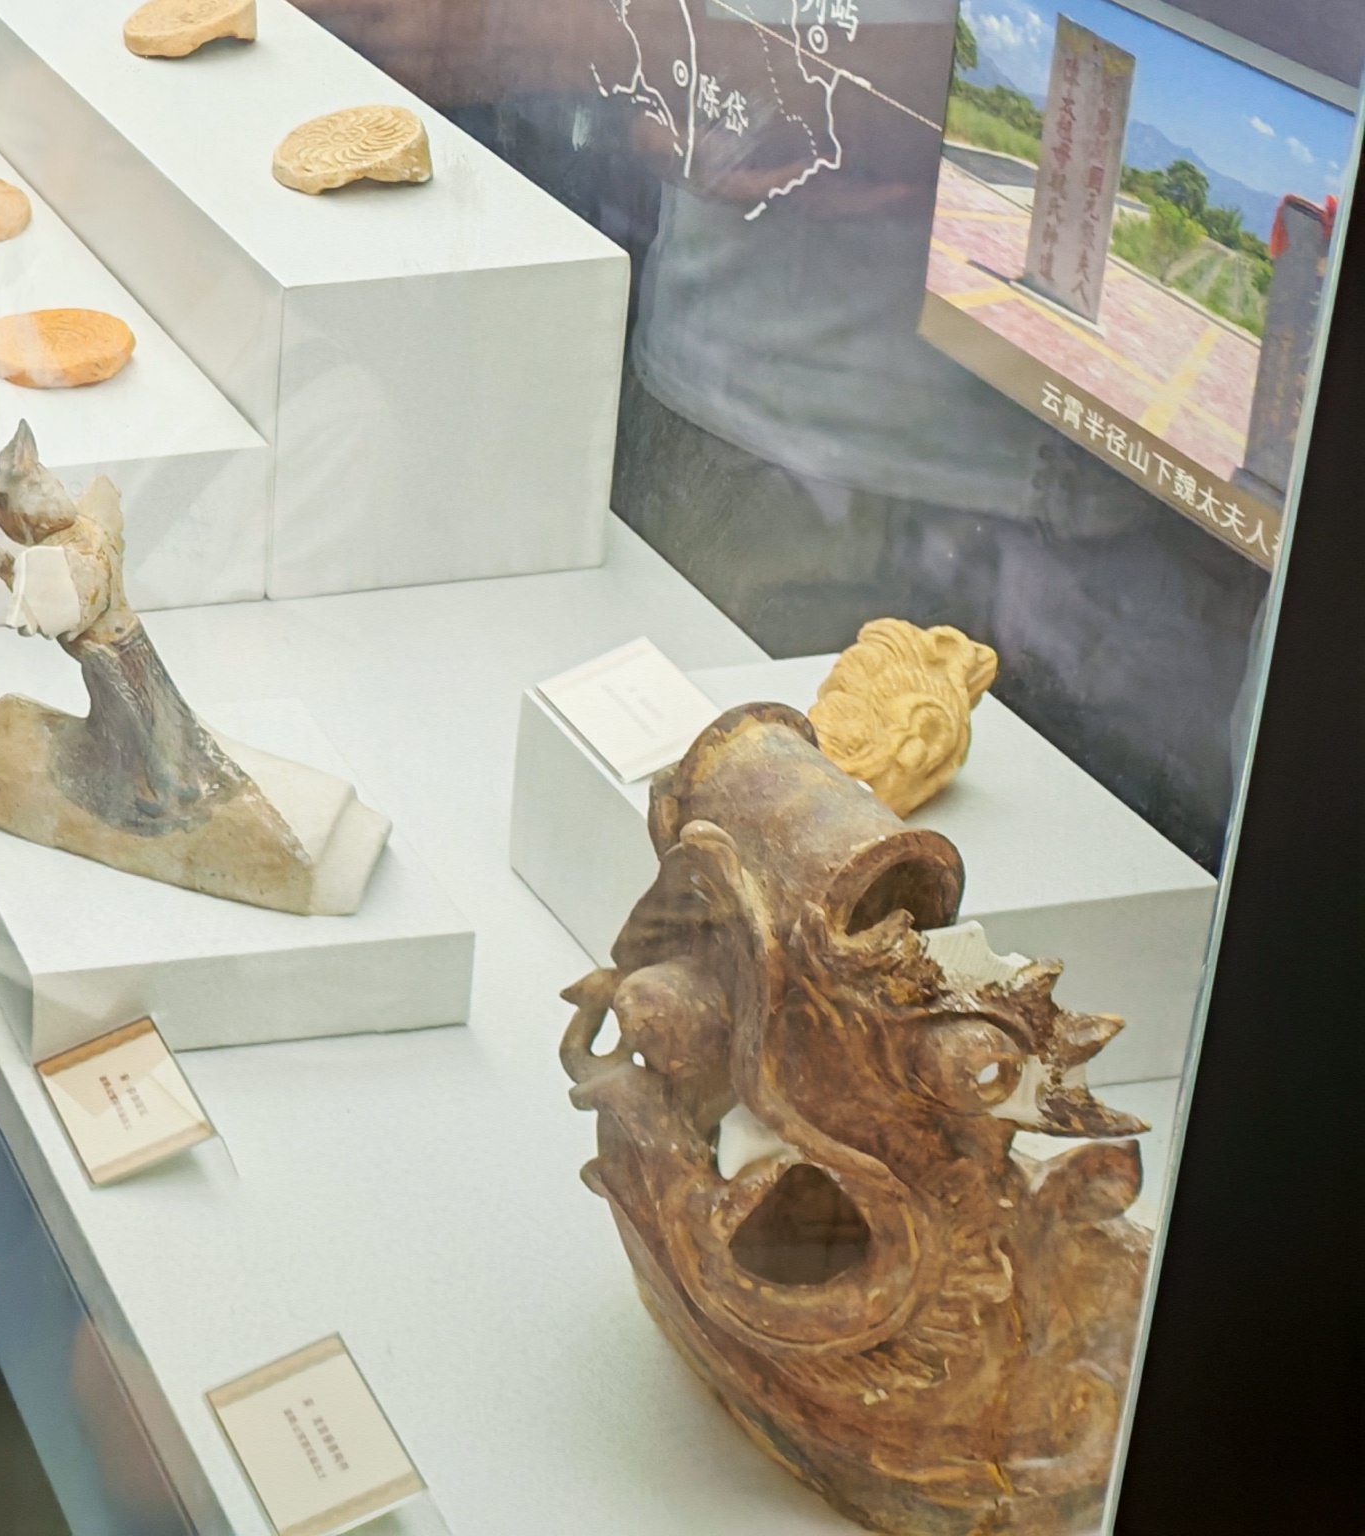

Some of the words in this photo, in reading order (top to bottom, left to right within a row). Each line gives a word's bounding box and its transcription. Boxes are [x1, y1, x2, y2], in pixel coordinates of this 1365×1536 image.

[697, 72, 749, 138] 陈岱
[1039, 379, 1283, 566] 云霄半径山下魏太夫人
